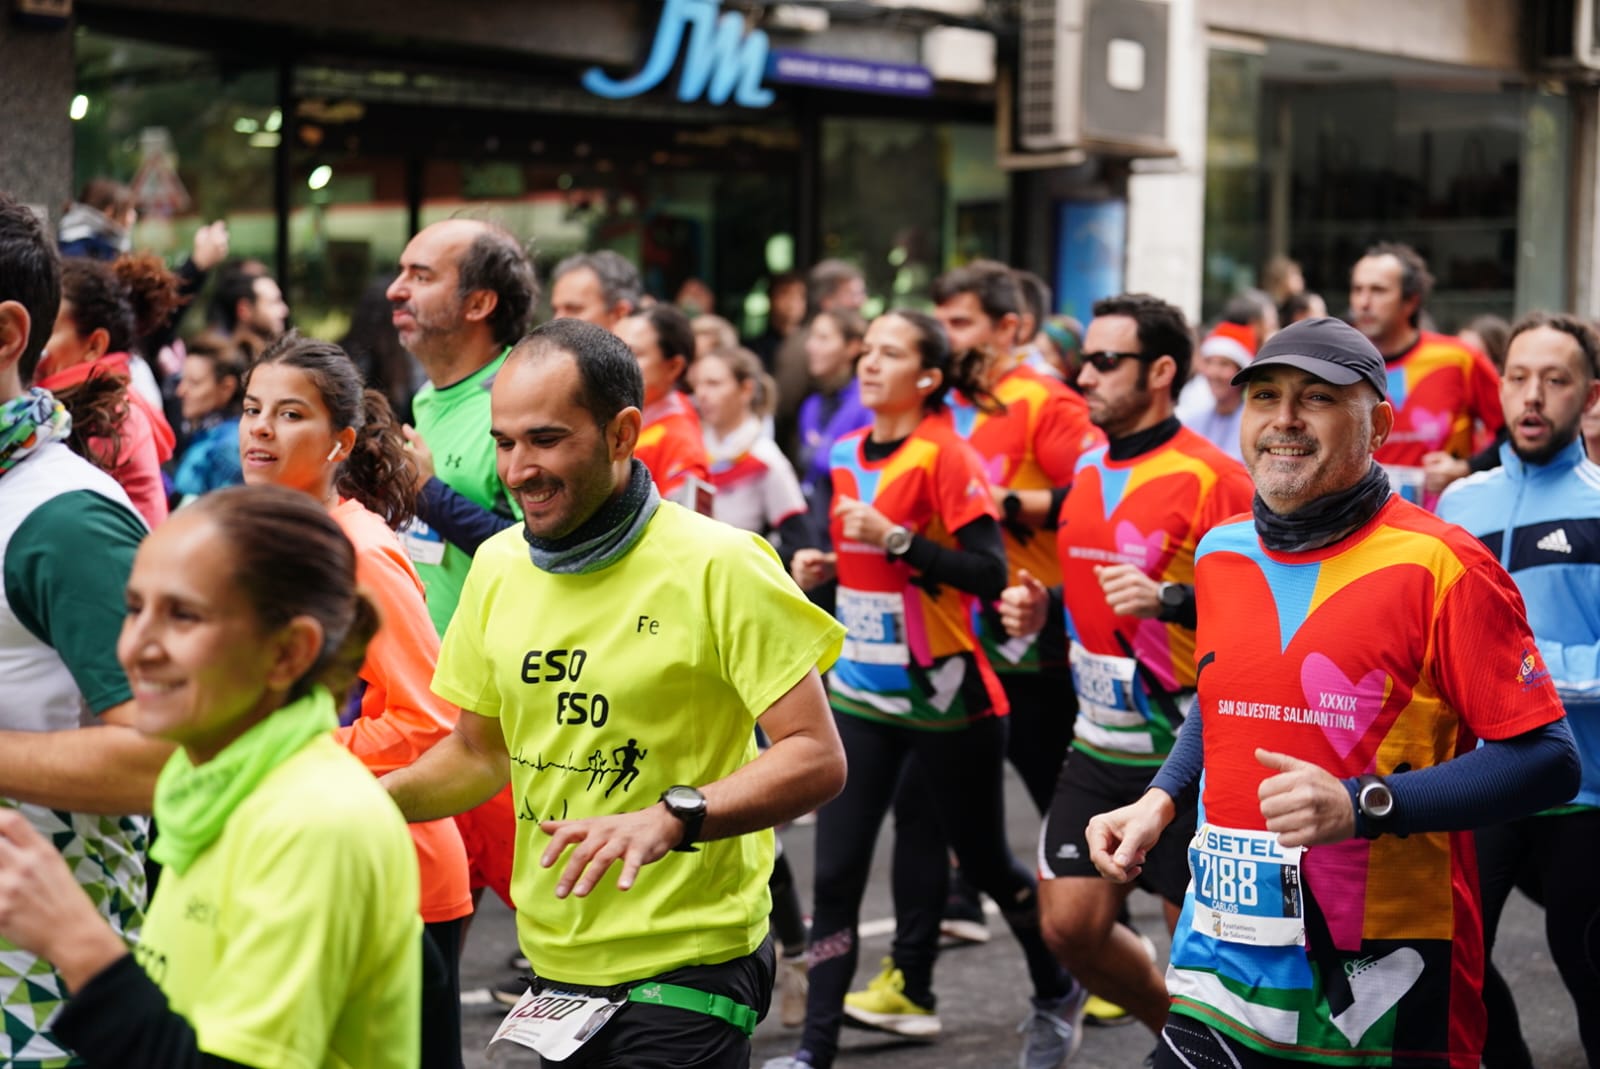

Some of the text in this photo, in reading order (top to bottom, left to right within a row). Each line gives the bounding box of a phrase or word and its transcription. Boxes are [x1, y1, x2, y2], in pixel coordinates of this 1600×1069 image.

[637, 615, 660, 635] Fe
[521, 649, 587, 684] ESO
[1218, 699, 1356, 731] SAN SILVESTRE SALMANTINA
[1319, 692, 1357, 712] XXXIX
[1207, 832, 1284, 859] SETEL
[1199, 852, 1258, 906] 2188
[1211, 900, 1239, 914] CARLOS
